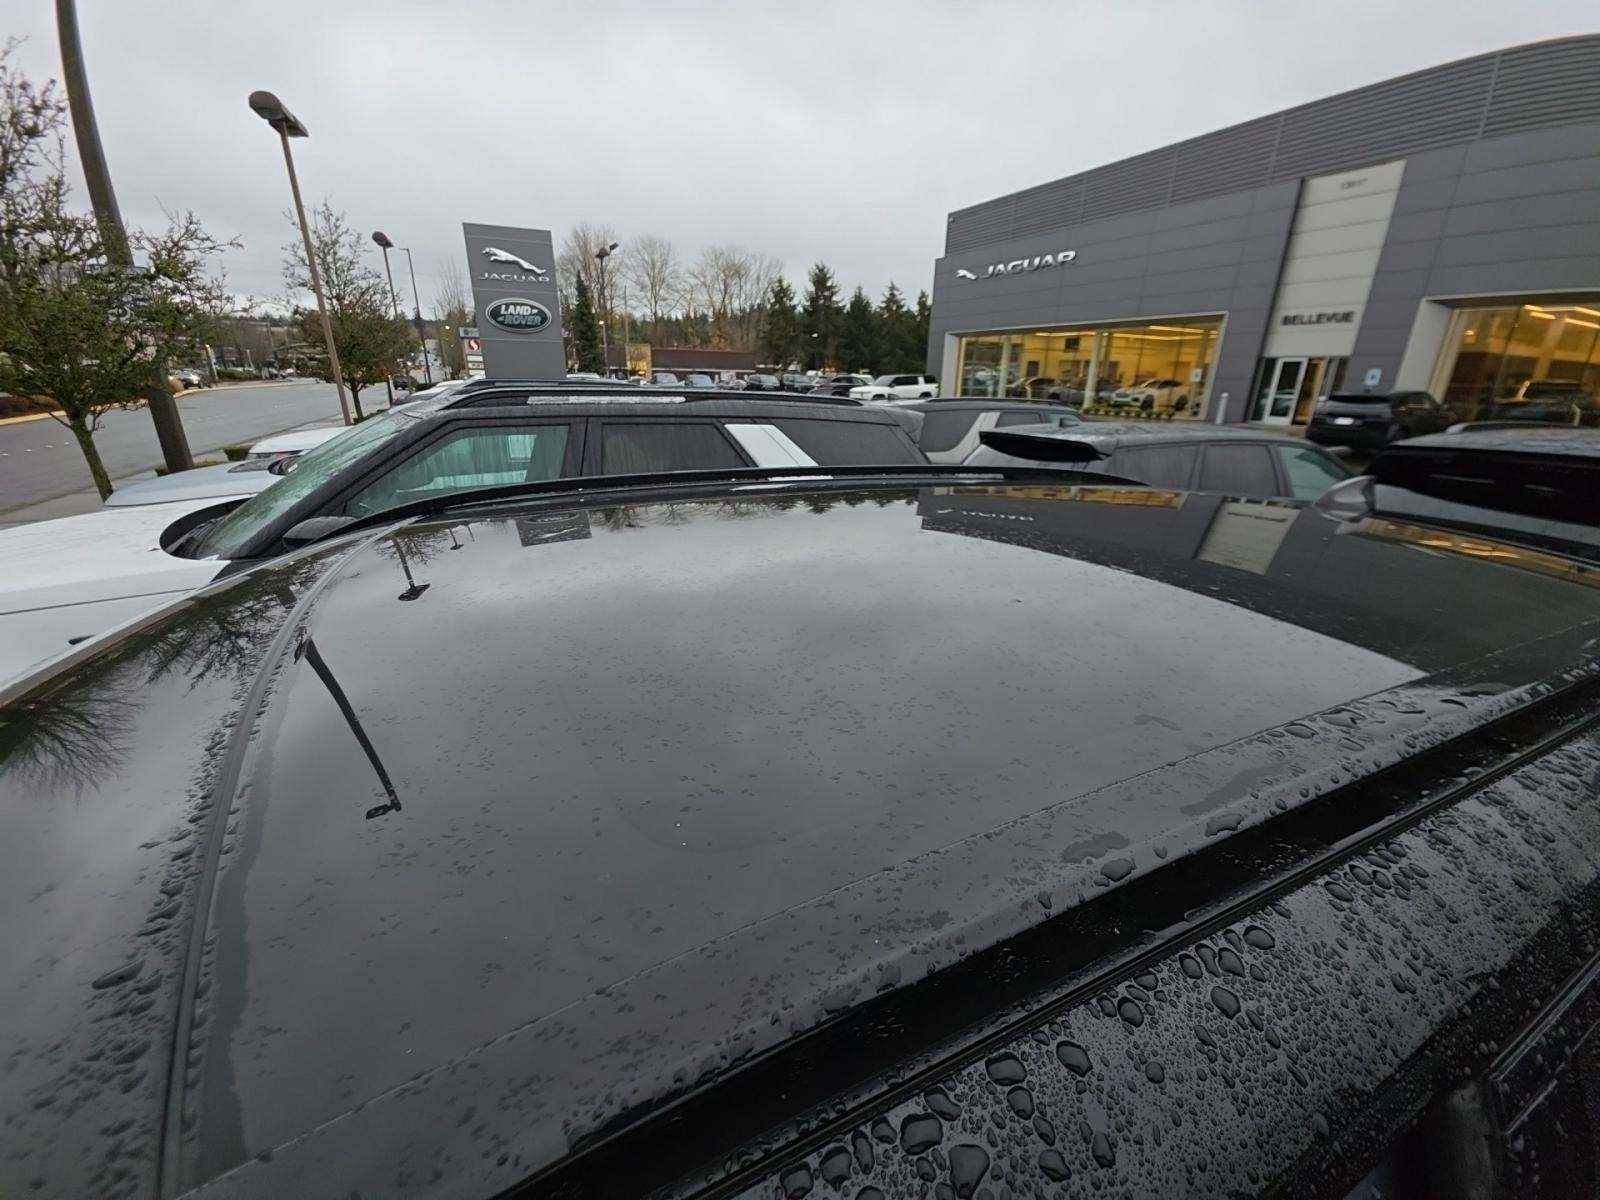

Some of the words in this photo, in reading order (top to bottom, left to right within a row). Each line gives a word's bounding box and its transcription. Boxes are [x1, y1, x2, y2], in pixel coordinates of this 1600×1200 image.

[982, 250, 1076, 279] JAGUAR
[500, 304, 532, 316] LAND
[504, 314, 542, 325] ROVER
[1281, 310, 1355, 327] BELLEVUE
